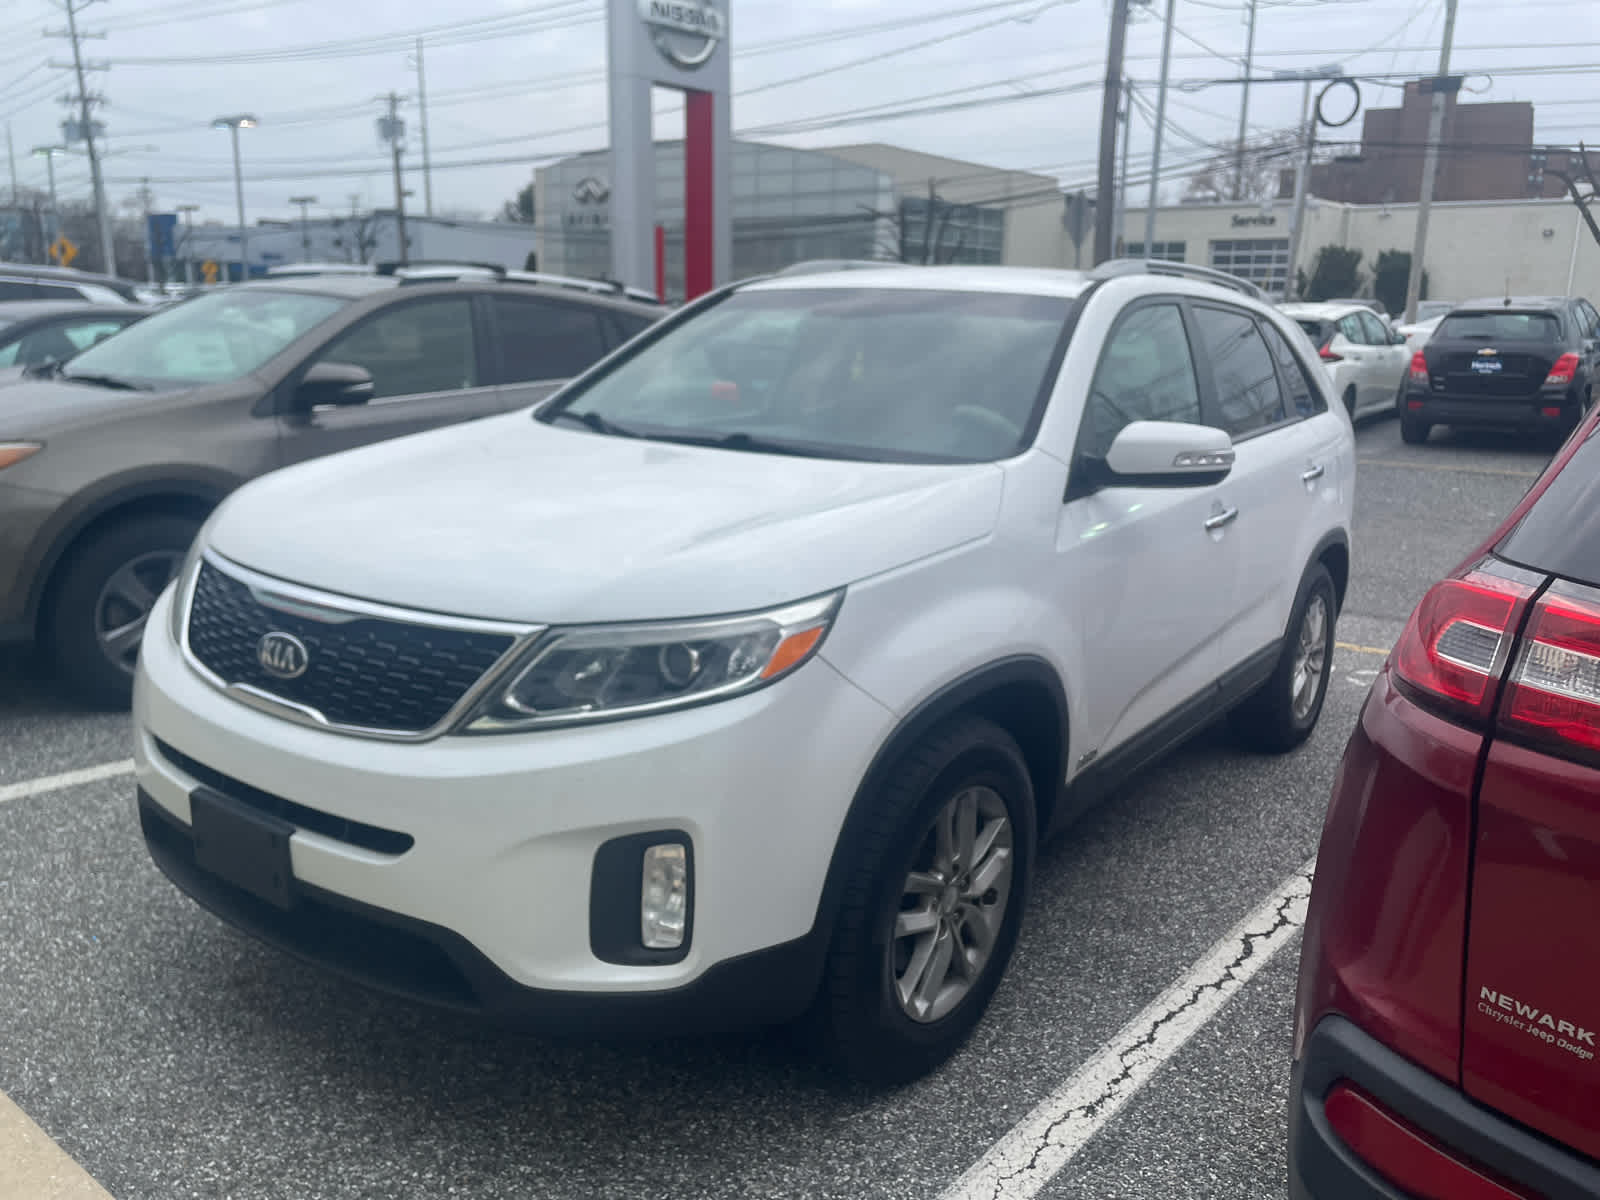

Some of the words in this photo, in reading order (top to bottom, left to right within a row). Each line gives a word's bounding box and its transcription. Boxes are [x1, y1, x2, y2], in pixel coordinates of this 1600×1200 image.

[650, 1, 719, 30] NISSAN
[262, 639, 295, 671] KIA
[1477, 1002, 1527, 1030] Chrysler
[1526, 1023, 1555, 1044] Jeep
[1556, 1038, 1594, 1060] Dodge
[1480, 986, 1595, 1046] NEWARK
